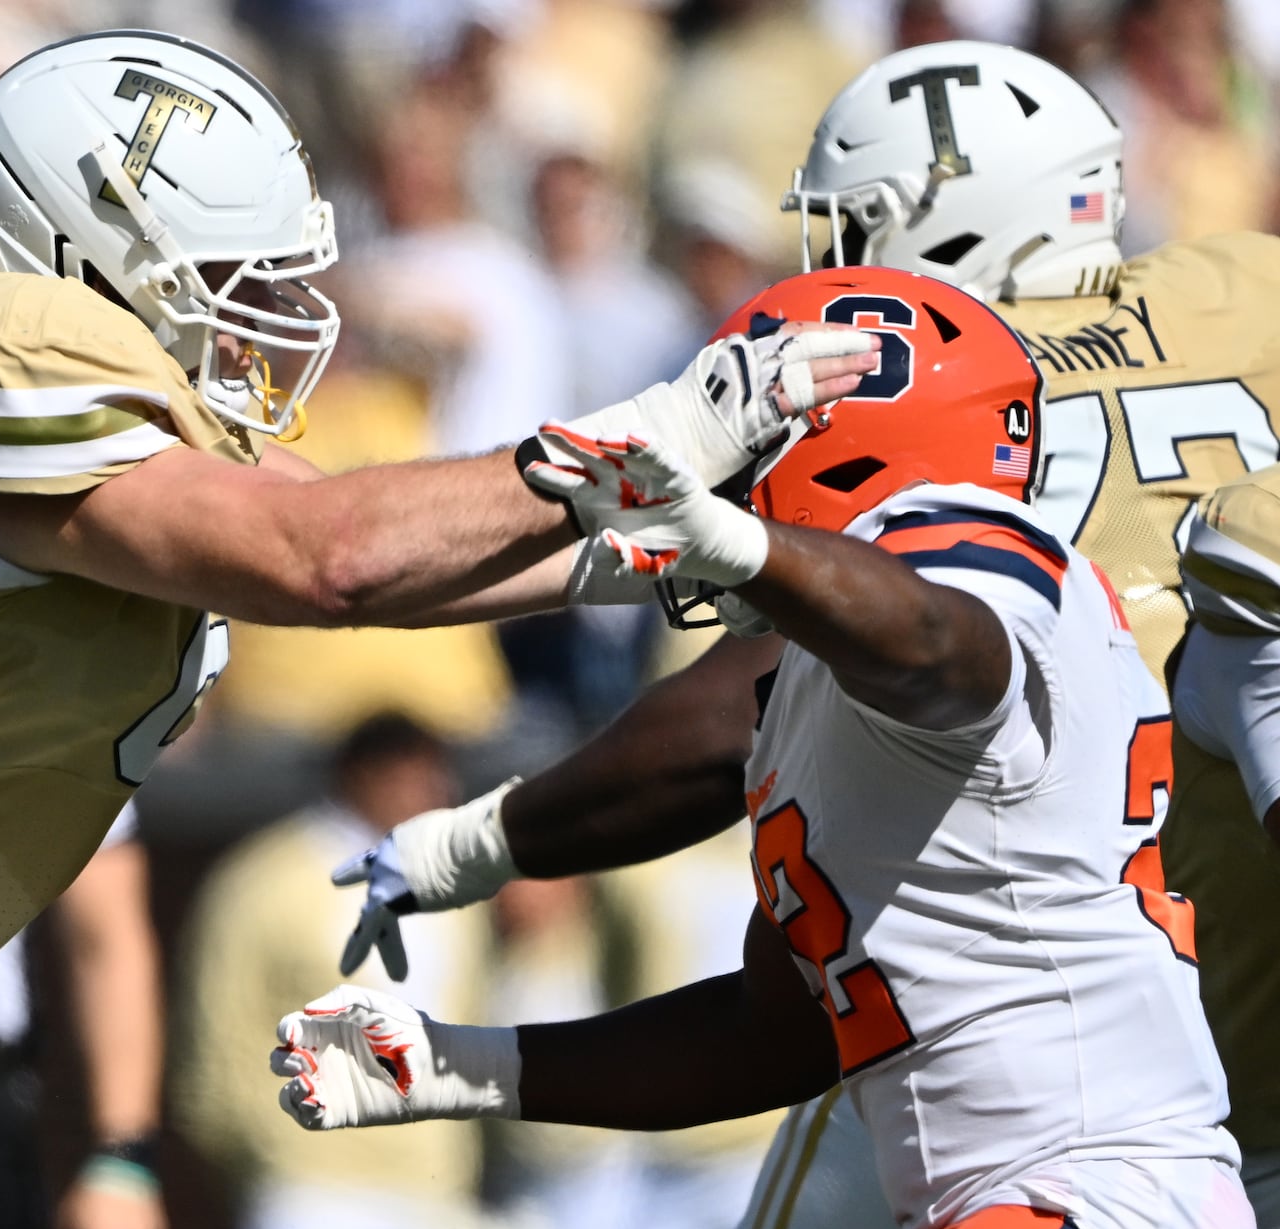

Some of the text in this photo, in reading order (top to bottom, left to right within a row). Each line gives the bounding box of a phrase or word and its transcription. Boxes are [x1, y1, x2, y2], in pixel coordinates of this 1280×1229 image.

[132, 75, 204, 113] GEORGIA
[130, 107, 163, 171] TECH
[821, 294, 916, 402] S
[1007, 405, 1030, 436] AJ
